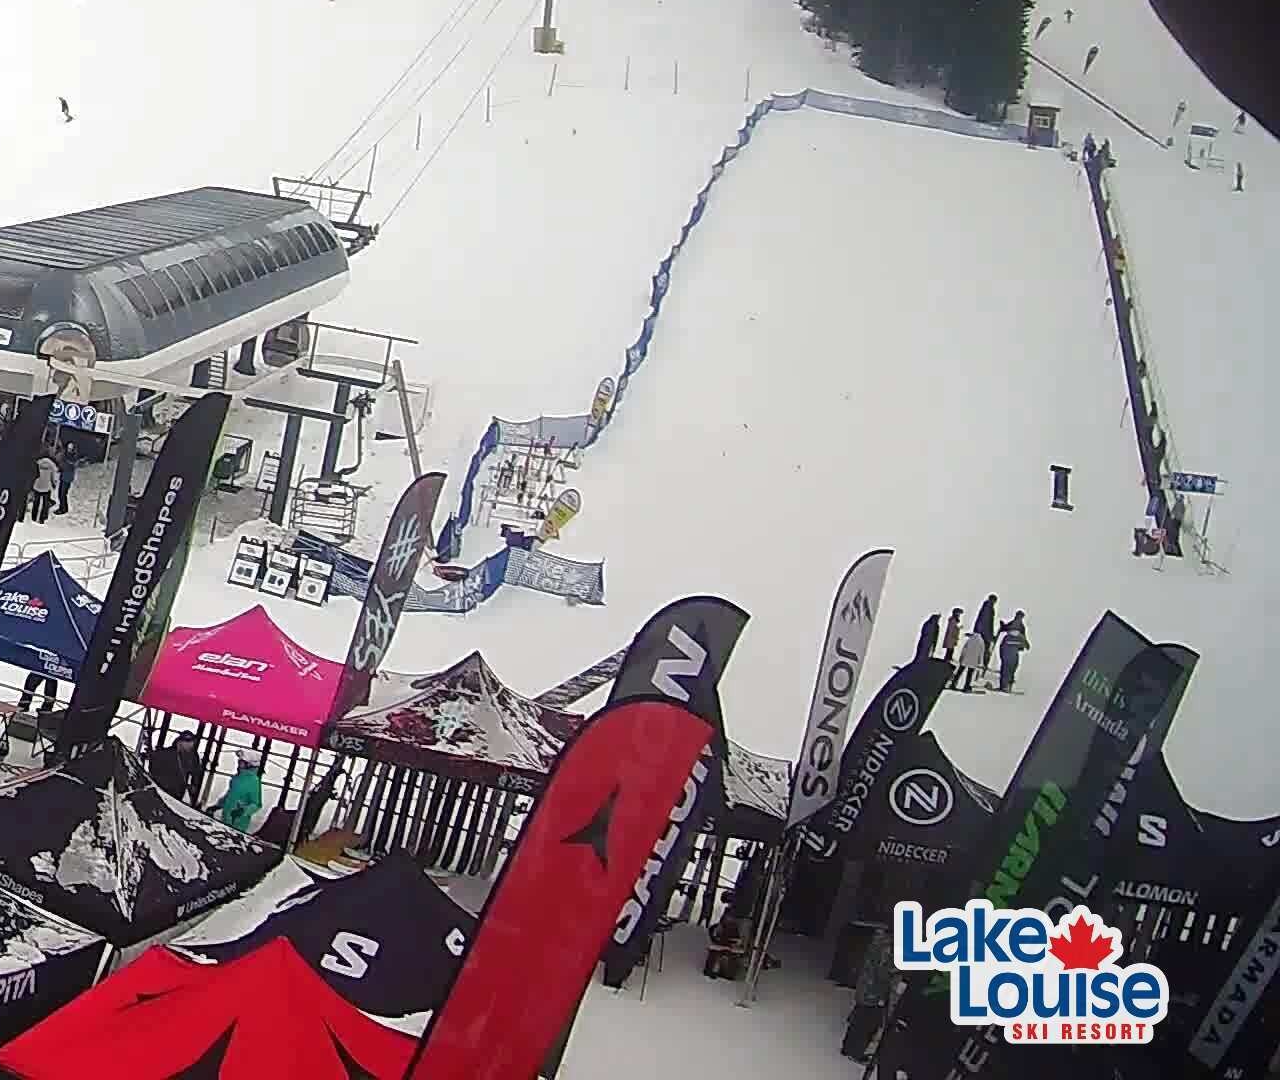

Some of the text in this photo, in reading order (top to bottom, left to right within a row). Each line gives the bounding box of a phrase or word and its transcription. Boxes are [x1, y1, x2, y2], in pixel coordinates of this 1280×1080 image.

[0, 600, 50, 619] Louise
[196, 651, 271, 673] elan
[222, 708, 309, 738] PLAYMAKER
[838, 732, 894, 833] NIDECKER
[877, 839, 948, 864] NIDECKER
[1113, 880, 1198, 906] ALOMON
[1201, 922, 1280, 1047] RMADA
